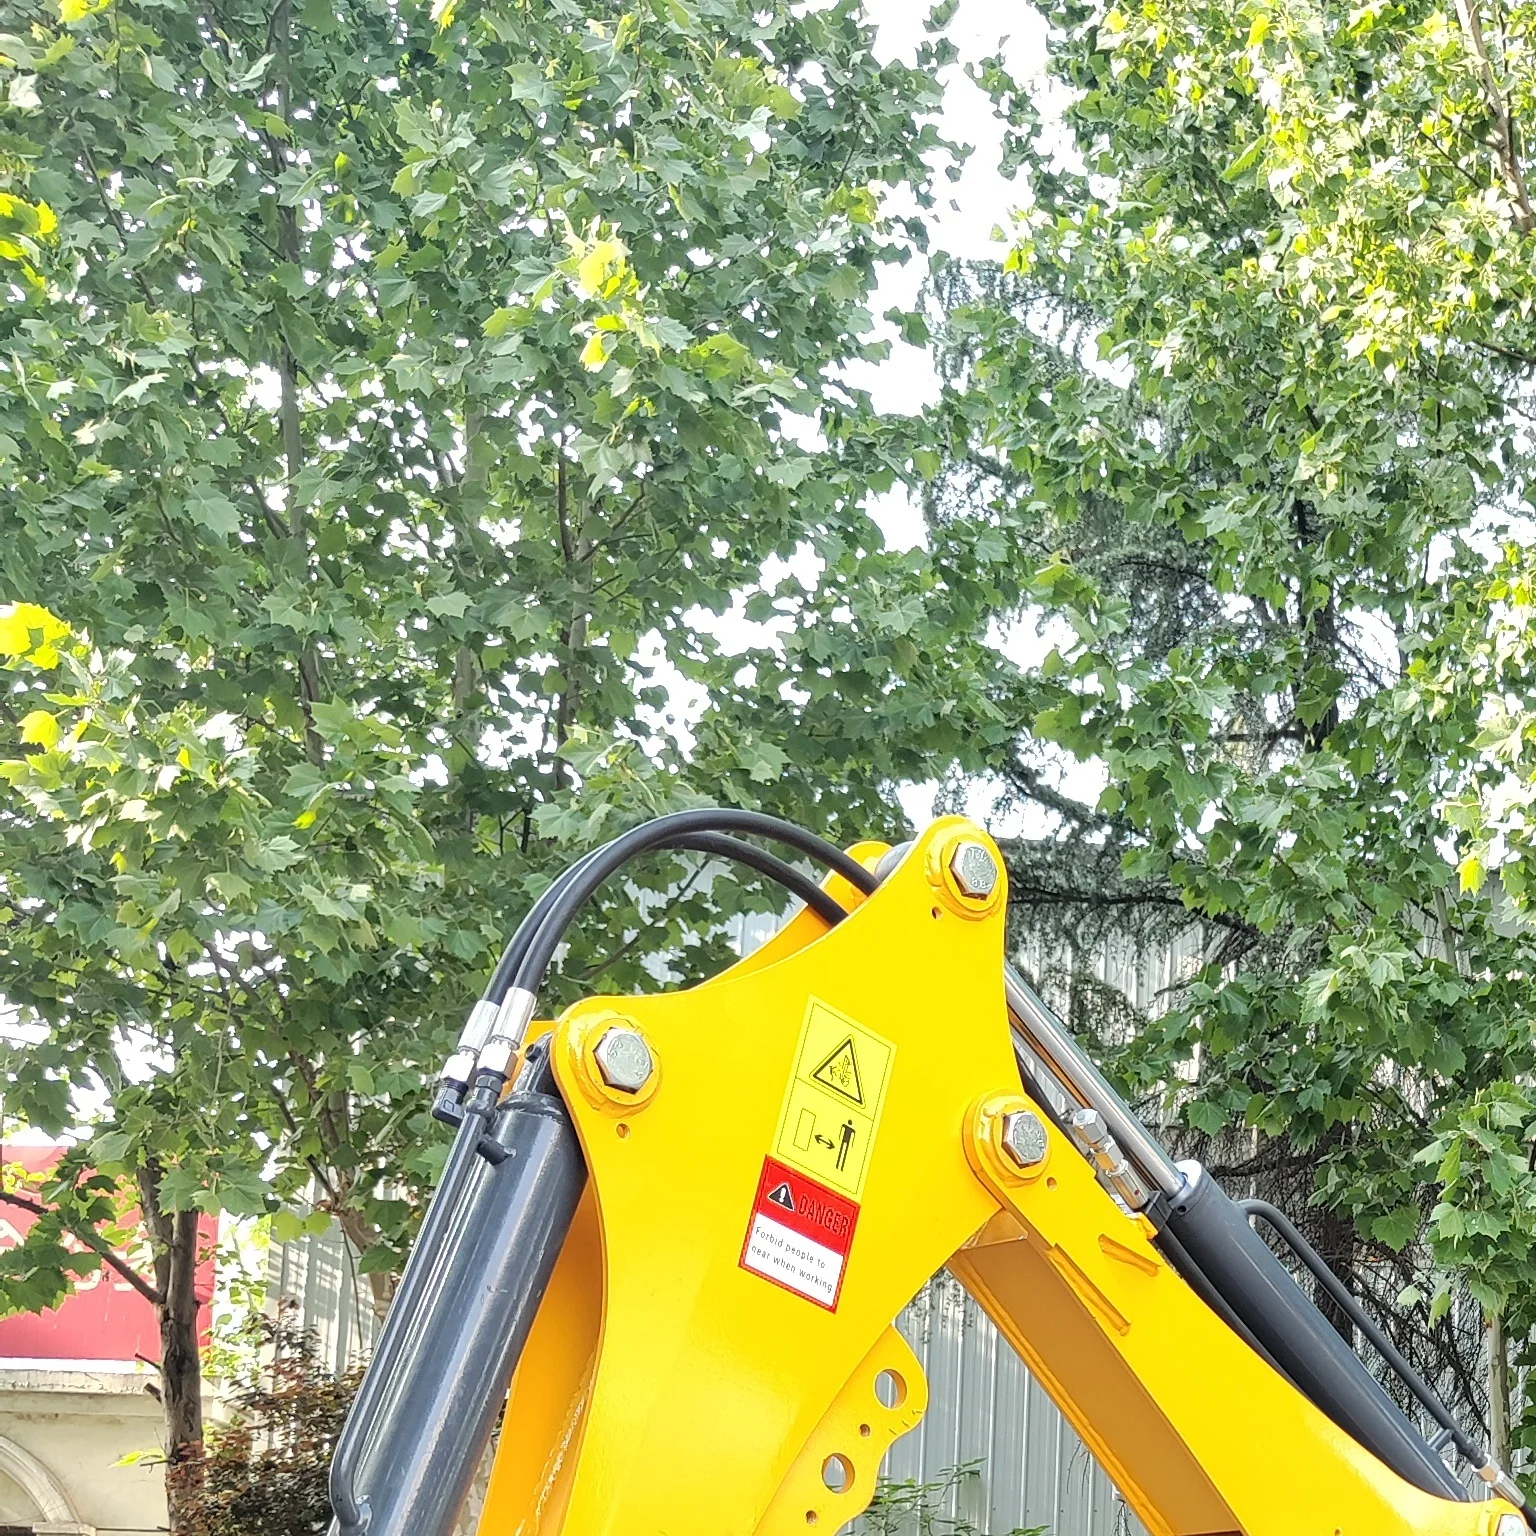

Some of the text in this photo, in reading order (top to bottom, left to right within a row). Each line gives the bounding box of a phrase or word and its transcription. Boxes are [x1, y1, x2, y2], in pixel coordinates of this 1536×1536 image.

[798, 1194, 849, 1238] DANGER
[751, 1244, 833, 1293] near when working
[755, 1226, 826, 1269] Forbid people to
